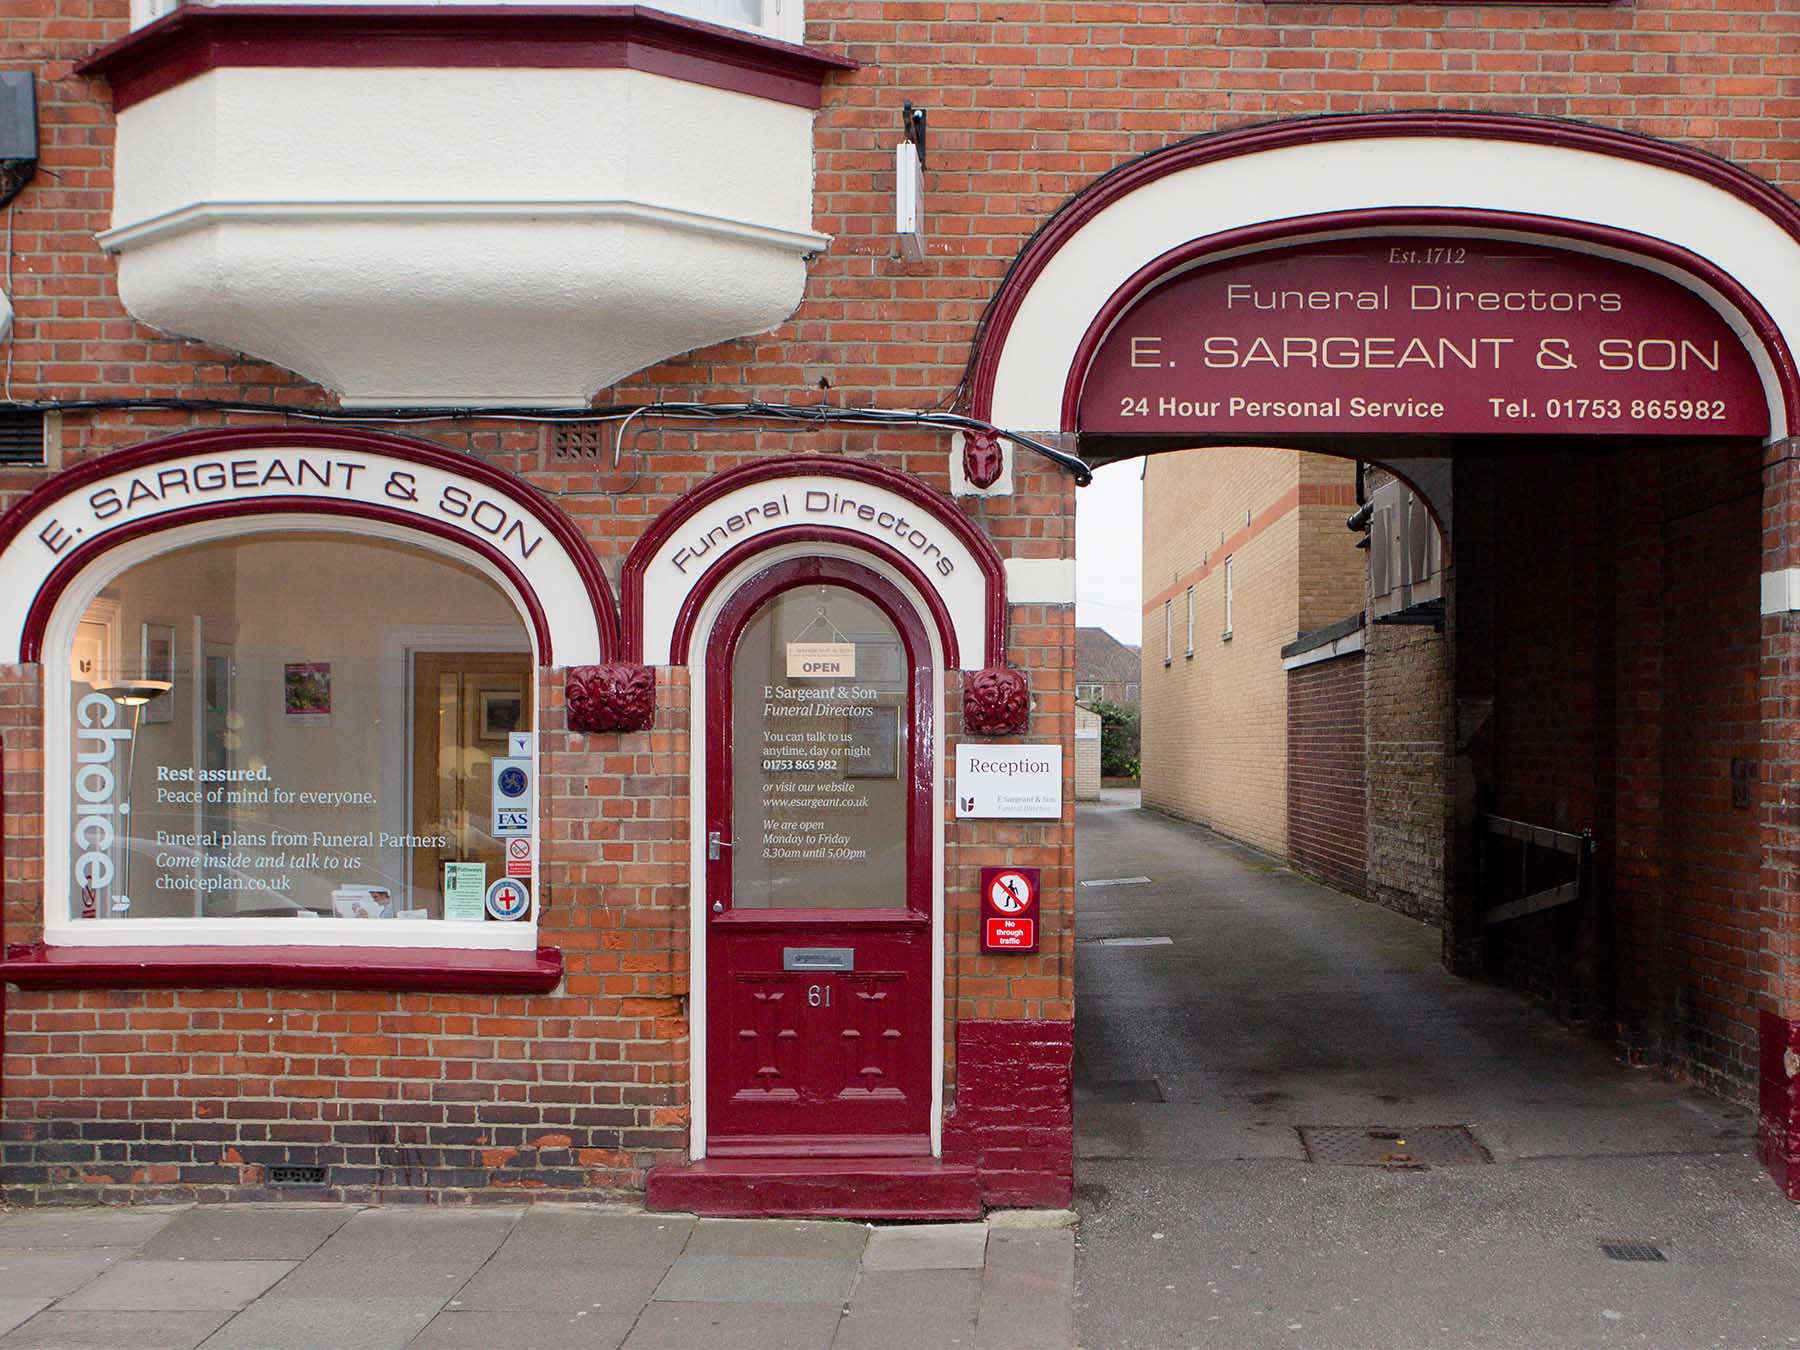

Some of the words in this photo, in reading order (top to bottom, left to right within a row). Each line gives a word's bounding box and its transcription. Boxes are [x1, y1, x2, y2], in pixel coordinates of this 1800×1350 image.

[1227, 284, 1389, 310] Funeral
[1411, 285, 1622, 312] Directors
[1130, 337, 1176, 368] E.
[1204, 337, 1514, 369] SARGEANT
[1536, 338, 1578, 370] &
[1599, 339, 1719, 372] SON
[1120, 397, 1149, 417] 24
[1159, 397, 1221, 418] Hour
[1229, 397, 1341, 418] Personal
[1350, 397, 1445, 418] Service
[1488, 398, 1537, 419] Tel.
[1546, 399, 1622, 420] 01753
[1630, 400, 1726, 421] 865982
[38, 519, 83, 556] E.
[89, 458, 366, 520] SARGEANT
[384, 471, 418, 502] &
[439, 486, 543, 559] SON
[671, 493, 789, 573] Funeral
[805, 490, 955, 577] Directors
[802, 662, 841, 673] OPEN
[764, 686, 773, 699] E
[775, 686, 834, 702] Sargeant
[838, 686, 849, 699] &
[851, 686, 877, 699] Son
[763, 703, 814, 717] Funeral
[815, 703, 874, 717] Directors
[763, 731, 783, 742] You
[785, 732, 804, 742] can
[806, 731, 827, 742] talk
[828, 732, 839, 742] to
[841, 732, 853, 742] us
[763, 745, 808, 757] anytime,
[810, 745, 829, 758] day
[831, 747, 843, 757] or
[844, 745, 871, 758] night
[157, 766, 195, 781] Rest
[199, 765, 272, 781] assured.
[763, 760, 793, 770] 01753
[795, 760, 815, 770] 865
[817, 760, 837, 770] 982
[970, 758, 1049, 776] Reception
[75, 692, 133, 890] choice
[762, 783, 774, 792] or
[776, 781, 796, 792] visit
[798, 782, 815, 792] our
[817, 781, 855, 792] website
[157, 788, 202, 803] Peace
[207, 788, 224, 803] of
[227, 788, 268, 803] mind
[273, 788, 298, 803] for
[300, 791, 377, 807] everyone.
[763, 797, 869, 809] www.esargeant.co.uk
[498, 813, 528, 825] FAS
[763, 819, 779, 830] We
[781, 821, 797, 830] are
[799, 821, 825, 832] open
[156, 831, 218, 847] Funeral
[221, 831, 266, 849] plans
[271, 831, 308, 846] from
[313, 831, 373, 847] Funeral
[763, 833, 805, 846] Monday
[806, 835, 816, 844] to
[818, 833, 850, 846] Friday
[156, 853, 200, 868] Come
[203, 852, 252, 868] inside
[255, 852, 286, 868] and
[289, 852, 320, 869] talk
[323, 854, 339, 869] to
[343, 856, 361, 869] us
[762, 848, 801, 858] 8.30am
[802, 847, 826, 858] until
[827, 848, 866, 860] 5.00pm
[155, 874, 291, 893] choiceplan.co.uk
[996, 929, 1024, 937] through
[808, 984, 831, 1007] 61
